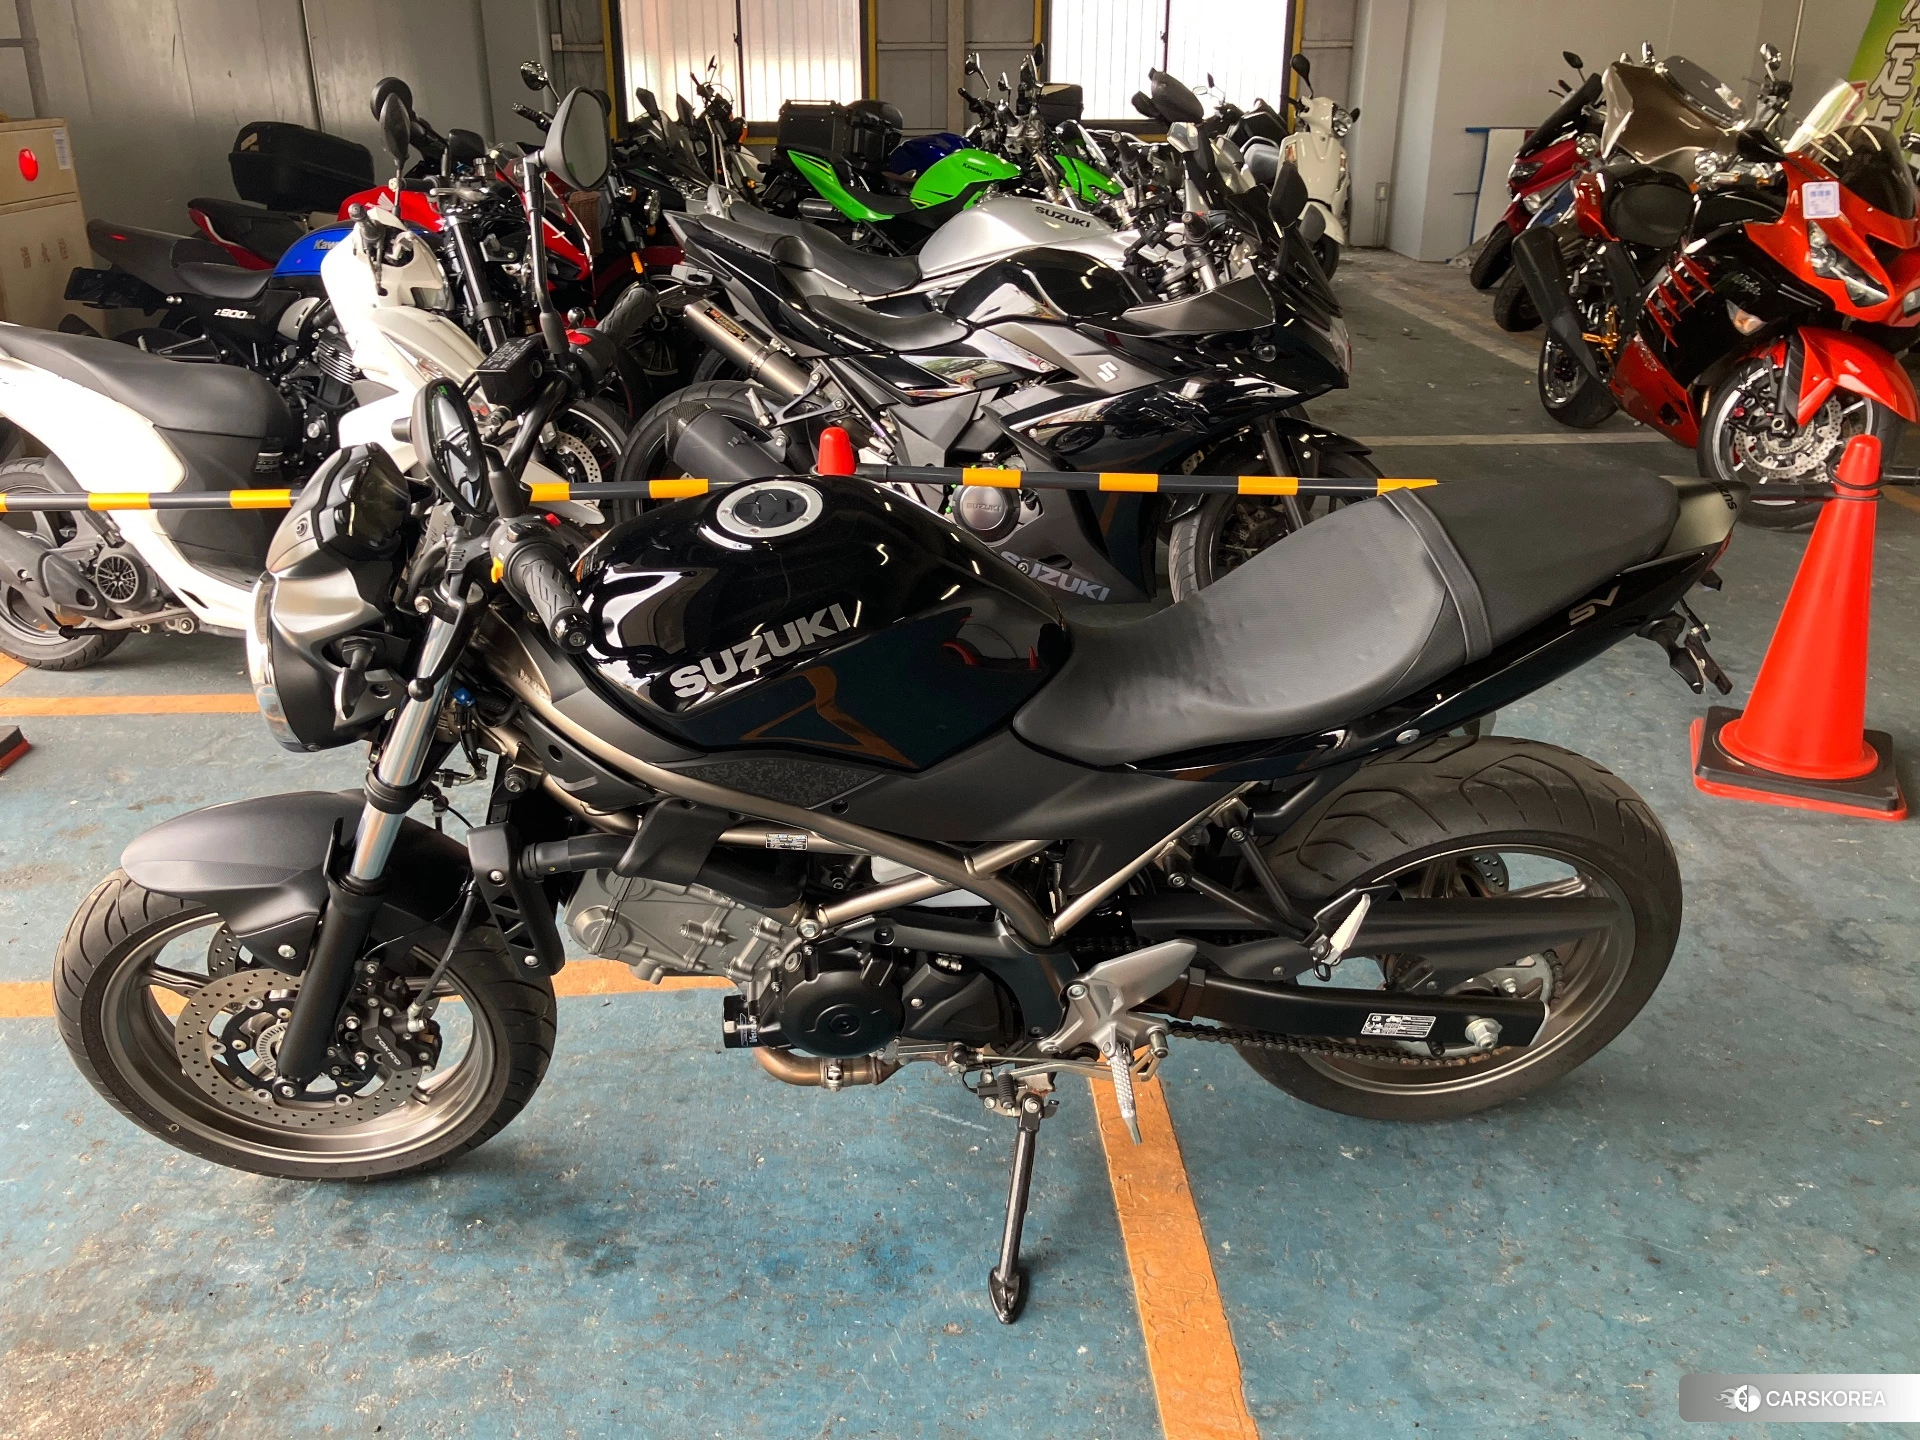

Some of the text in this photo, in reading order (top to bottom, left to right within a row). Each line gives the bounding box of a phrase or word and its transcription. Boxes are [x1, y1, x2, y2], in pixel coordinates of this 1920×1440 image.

[962, 163, 993, 177] Kawasaki
[1035, 205, 1091, 229] SUZUKI
[966, 502, 1001, 512] SUZUKI
[1715, 484, 1737, 510] SUZ
[1568, 585, 1620, 626] SV
[669, 603, 851, 698] SUZUKI
[374, 1034, 402, 1066] TOKICO
